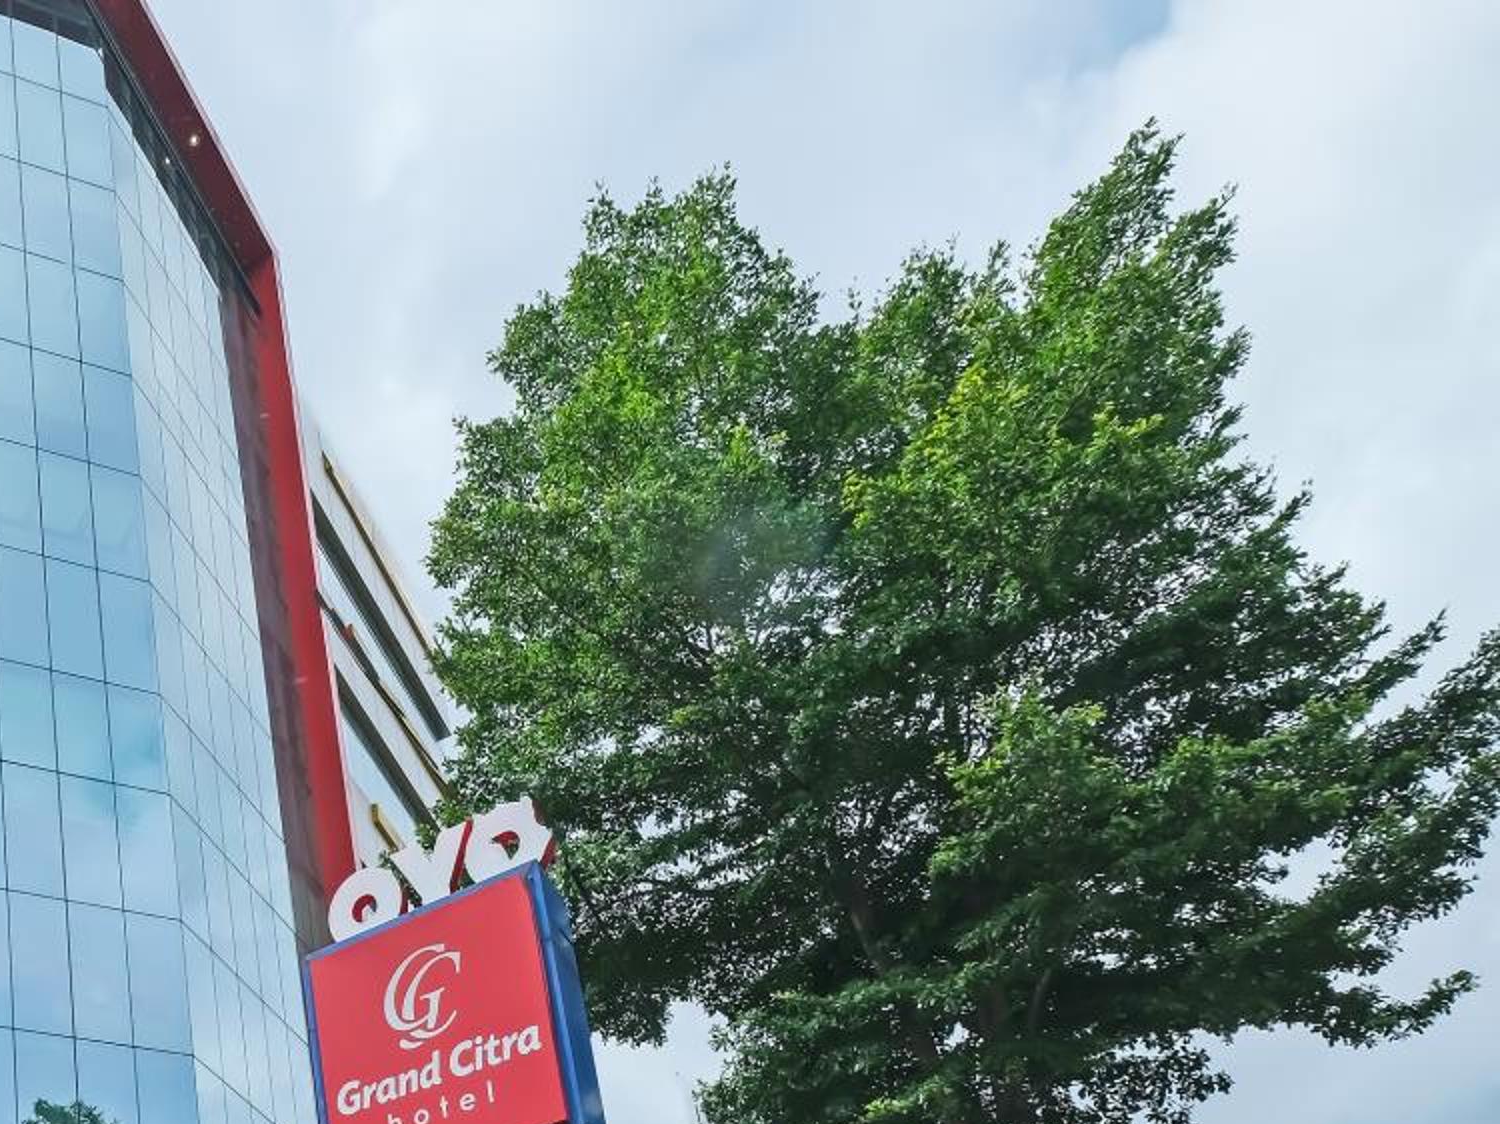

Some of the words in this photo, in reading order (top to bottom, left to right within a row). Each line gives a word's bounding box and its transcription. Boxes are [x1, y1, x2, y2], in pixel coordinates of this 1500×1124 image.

[328, 796, 555, 943] OYO
[337, 1051, 442, 1115] Grand
[450, 1025, 543, 1077] Citra
